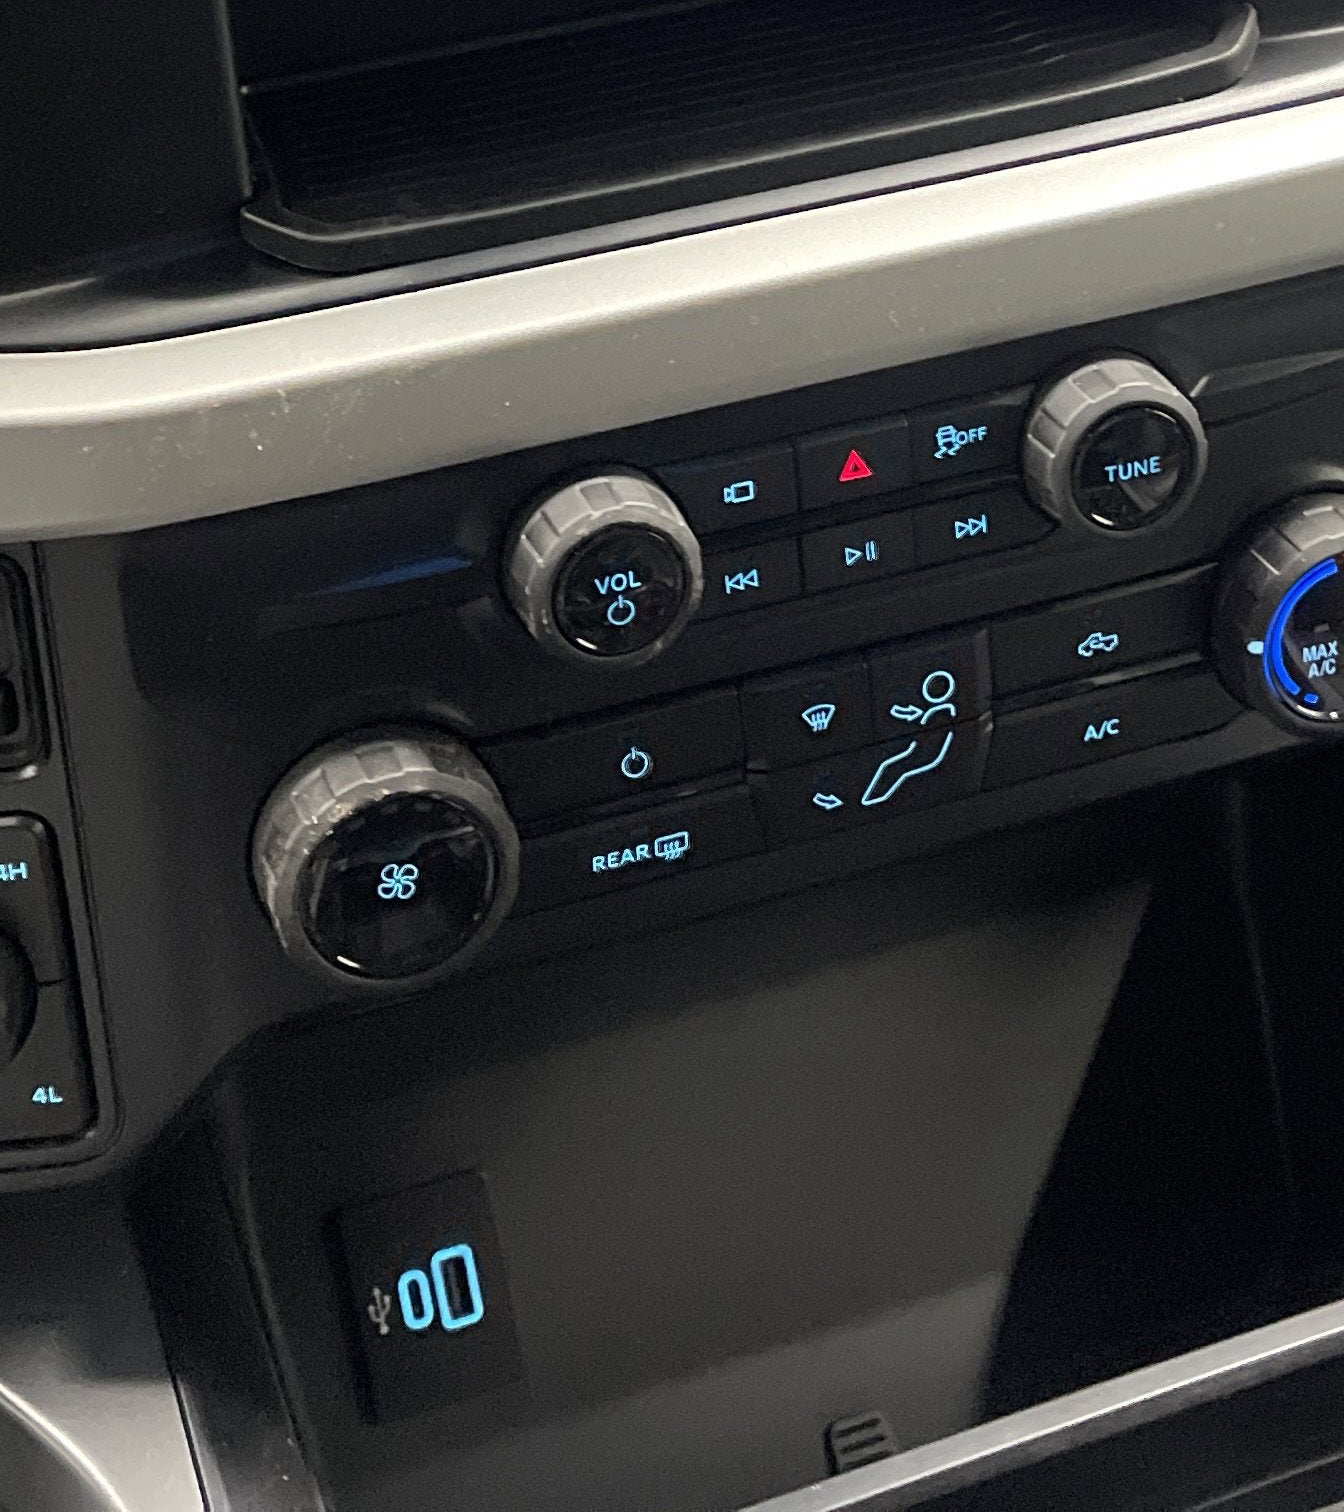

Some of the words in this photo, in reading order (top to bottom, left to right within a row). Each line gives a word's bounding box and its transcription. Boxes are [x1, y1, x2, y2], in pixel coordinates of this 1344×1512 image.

[956, 425, 988, 447] OFF
[1104, 456, 1163, 483] TUNE
[594, 569, 642, 596] VOL
[1302, 640, 1339, 663] MAX
[1308, 658, 1337, 679] A/C
[1083, 718, 1120, 742] A/C
[592, 844, 651, 873] REAR
[32, 1087, 64, 1104] 4L
